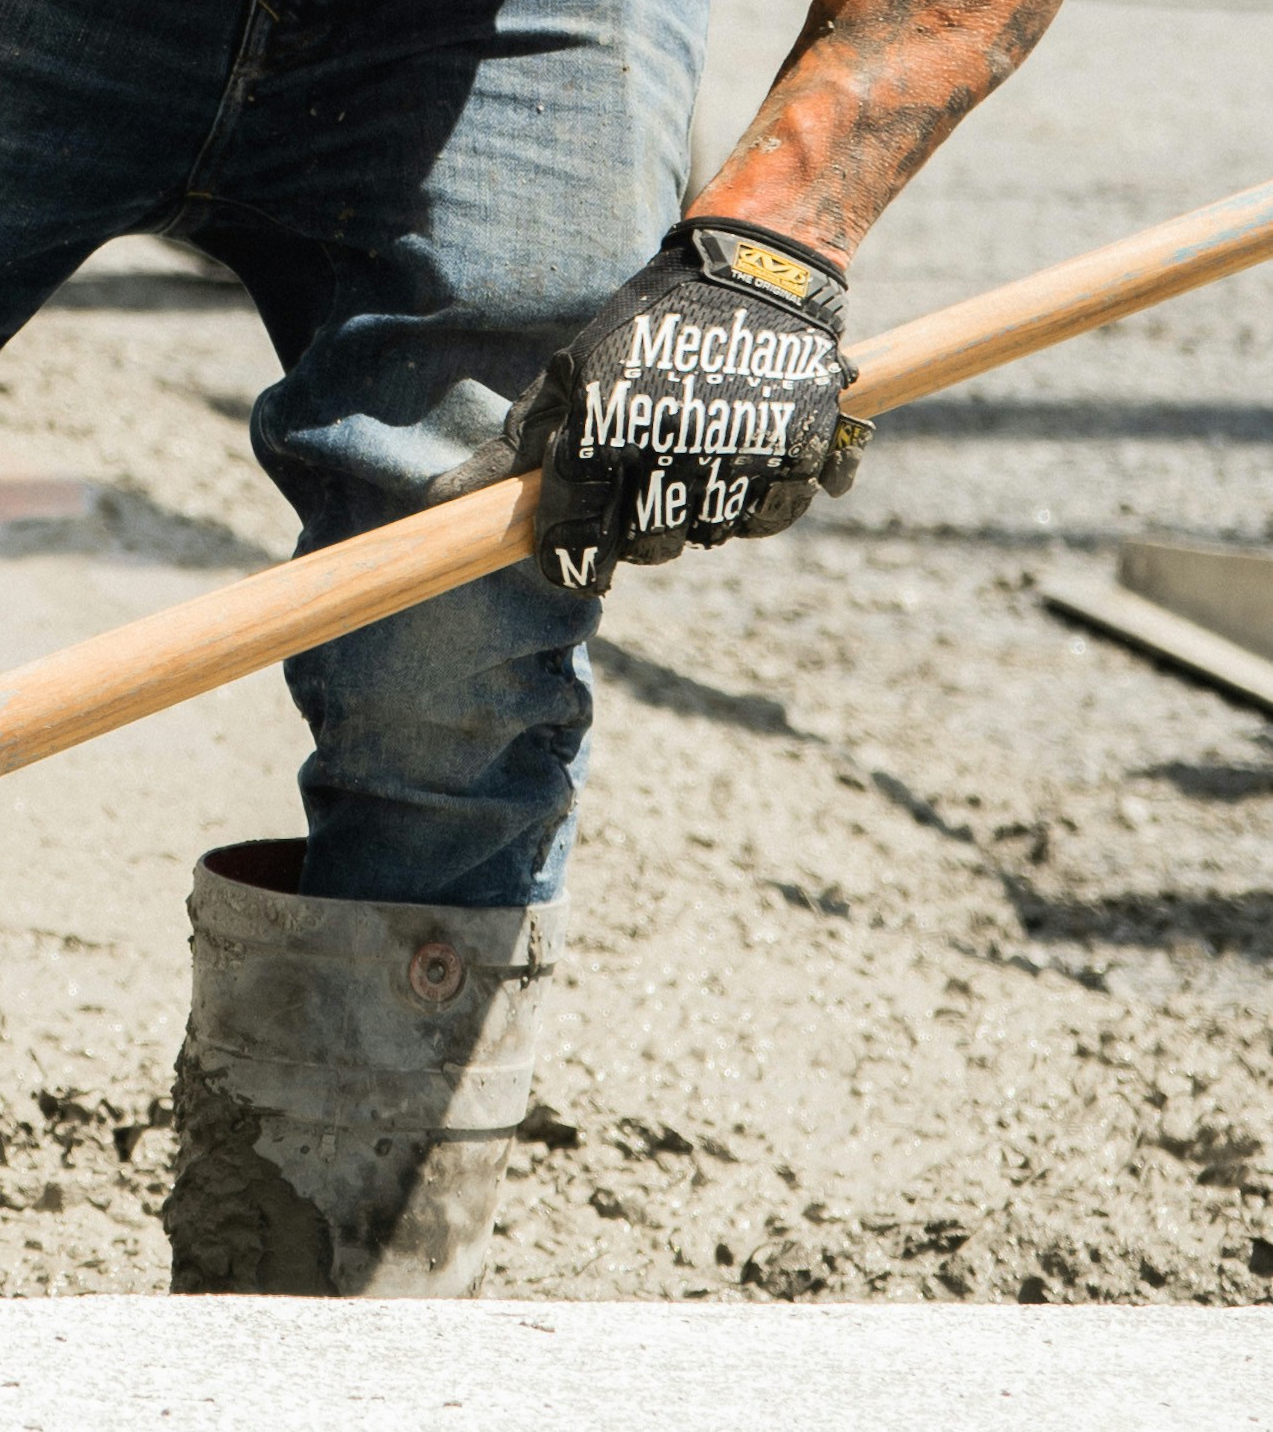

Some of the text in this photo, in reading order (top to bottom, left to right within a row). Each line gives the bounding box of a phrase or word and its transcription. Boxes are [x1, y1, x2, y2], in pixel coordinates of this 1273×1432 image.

[731, 269, 754, 285] THE
[754, 278, 803, 307] ORIGINAL
[626, 308, 835, 380] Mechanix
[624, 368, 831, 391] GLOVES
[580, 374, 795, 457] Mechanix
[579, 447, 783, 468] GOVES
